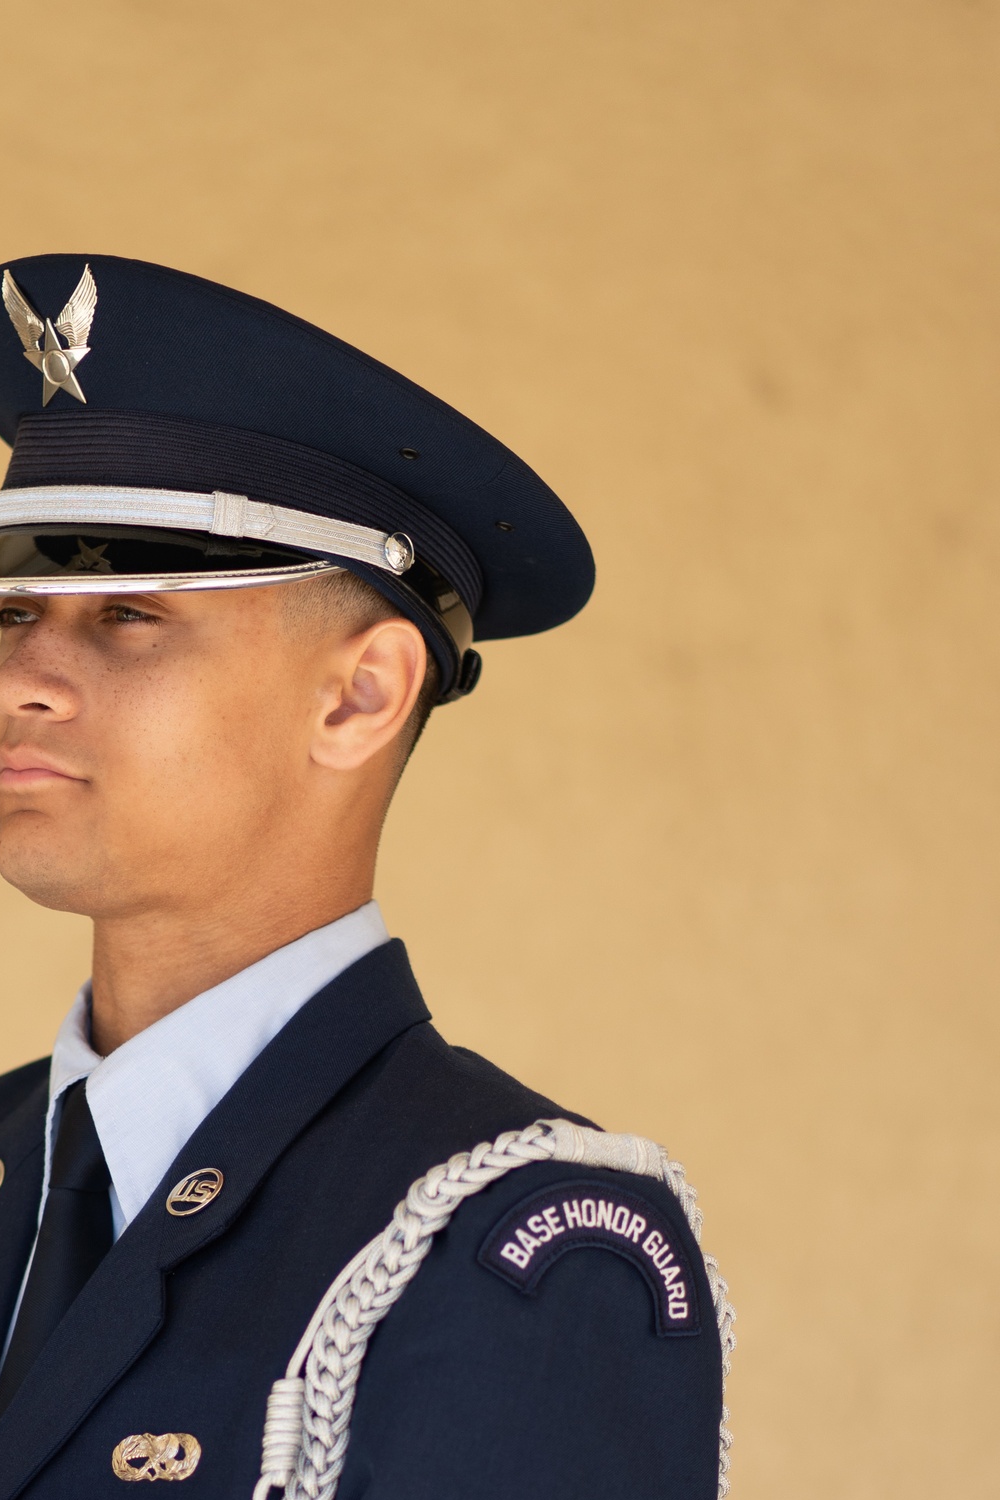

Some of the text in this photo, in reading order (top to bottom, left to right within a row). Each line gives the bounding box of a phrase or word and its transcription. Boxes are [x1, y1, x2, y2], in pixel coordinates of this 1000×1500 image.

[500, 1199, 688, 1319] BASE HONOR GUARD
